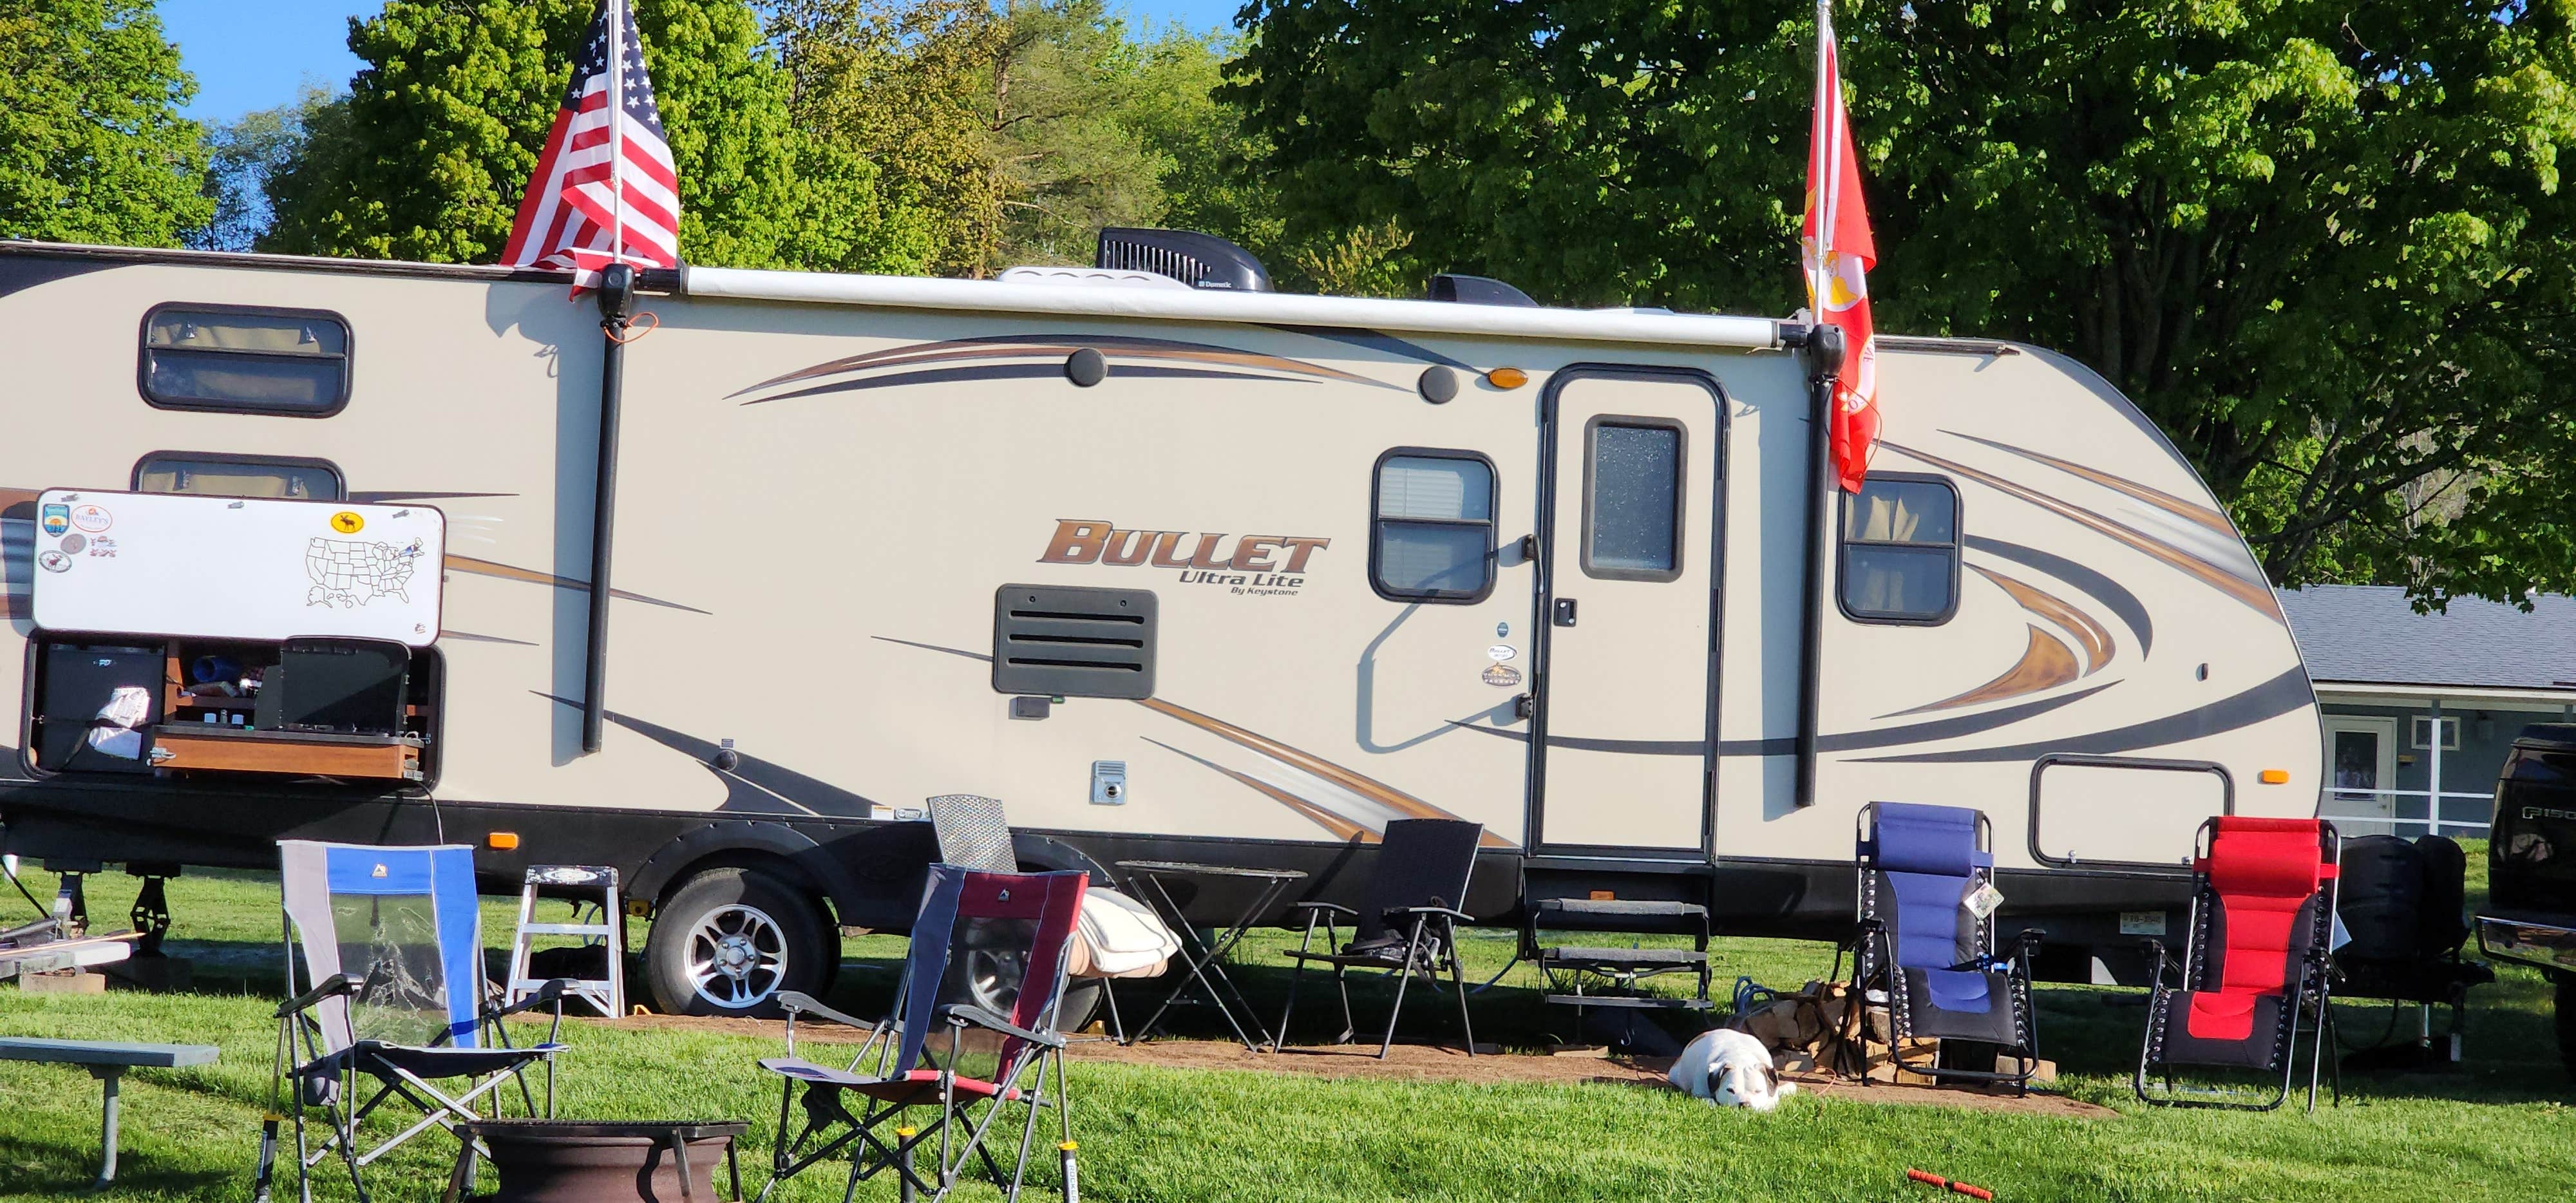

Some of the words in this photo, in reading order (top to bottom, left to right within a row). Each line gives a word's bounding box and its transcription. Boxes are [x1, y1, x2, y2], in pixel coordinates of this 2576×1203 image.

[1036, 518, 1332, 574] BULLET
[1179, 570, 1246, 585] Ultra
[1252, 573, 1304, 587] Lite
[1231, 587, 1245, 595] By
[1247, 587, 1298, 596] Keystone
[1069, 1165, 1077, 1202] ROCKER
